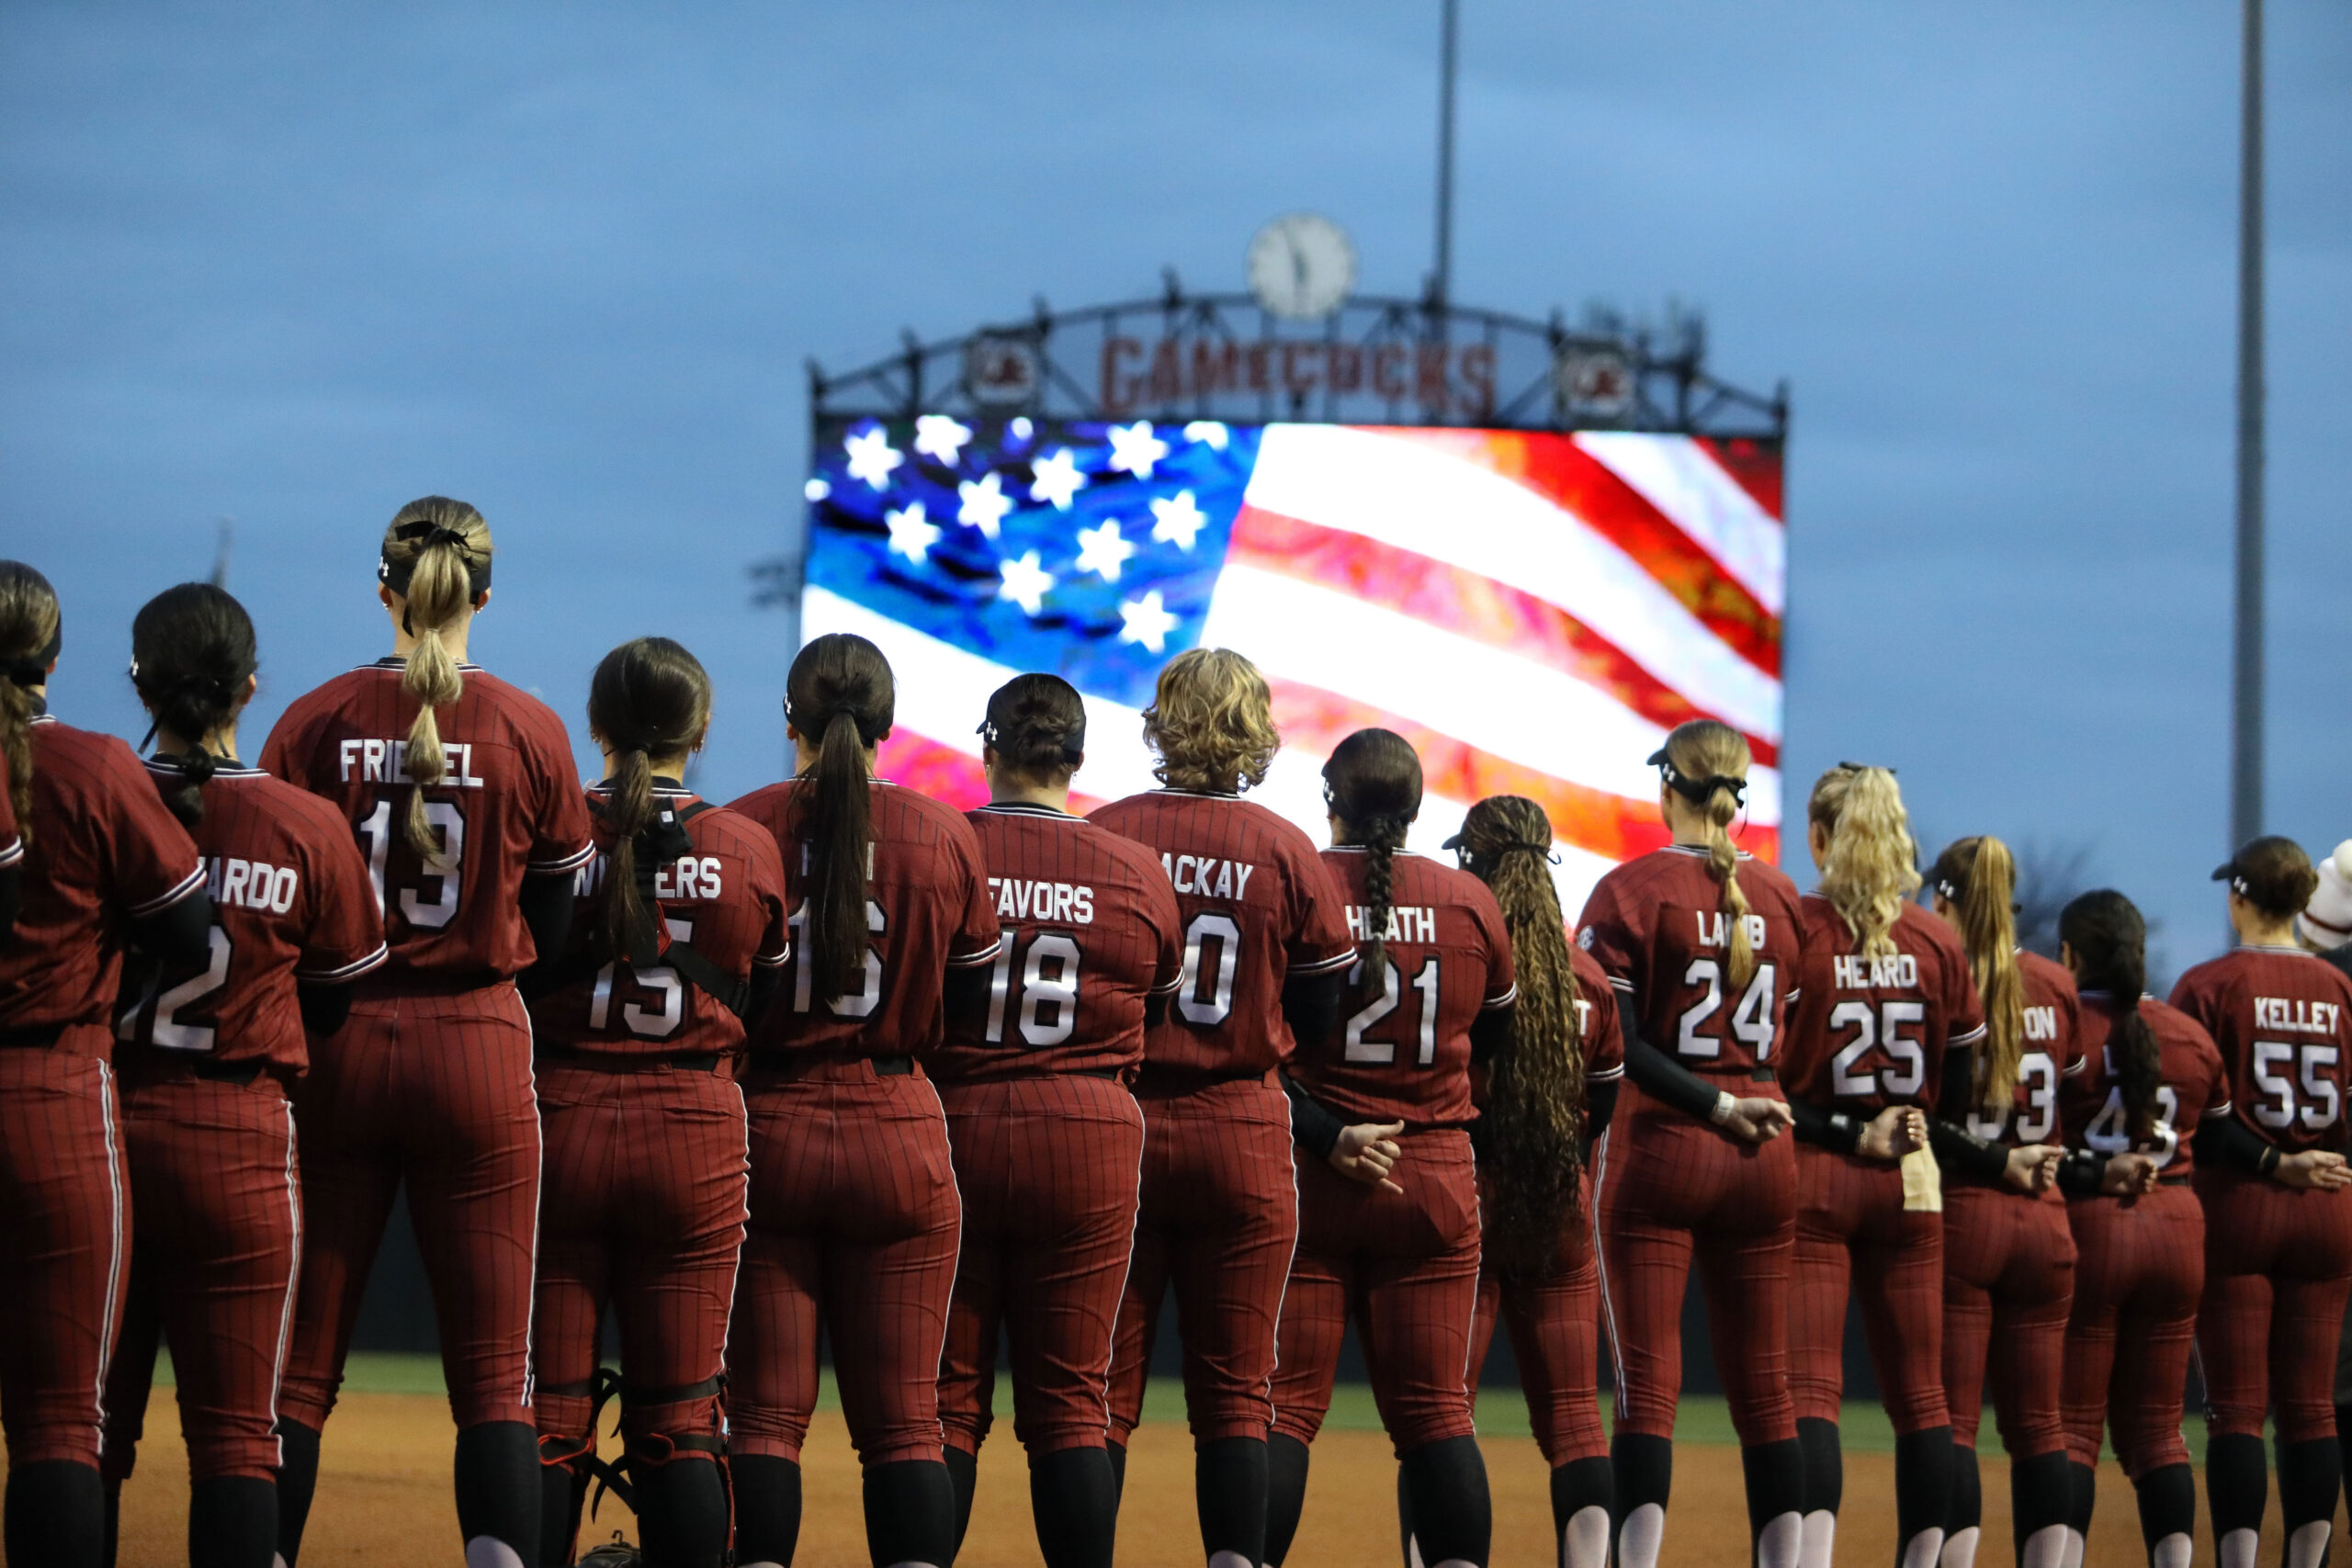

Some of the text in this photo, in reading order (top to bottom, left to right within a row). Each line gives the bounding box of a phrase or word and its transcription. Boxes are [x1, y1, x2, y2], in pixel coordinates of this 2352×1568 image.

[1100, 336, 1496, 419] GAMECOCKS
[341, 739, 483, 787] FRIEEL
[198, 856, 298, 914] ARDO
[360, 800, 464, 928] 13
[986, 931, 1080, 1045] 18
[1178, 914, 1239, 1025] 0
[1345, 960, 1438, 1065] 21
[1678, 959, 1775, 1061] 24
[1834, 954, 1917, 989] HEARD
[1829, 1001, 1925, 1096] 25
[2254, 996, 2339, 1035] KELLEY
[2084, 1085, 2178, 1169] 43
[2253, 1041, 2339, 1130] 55
